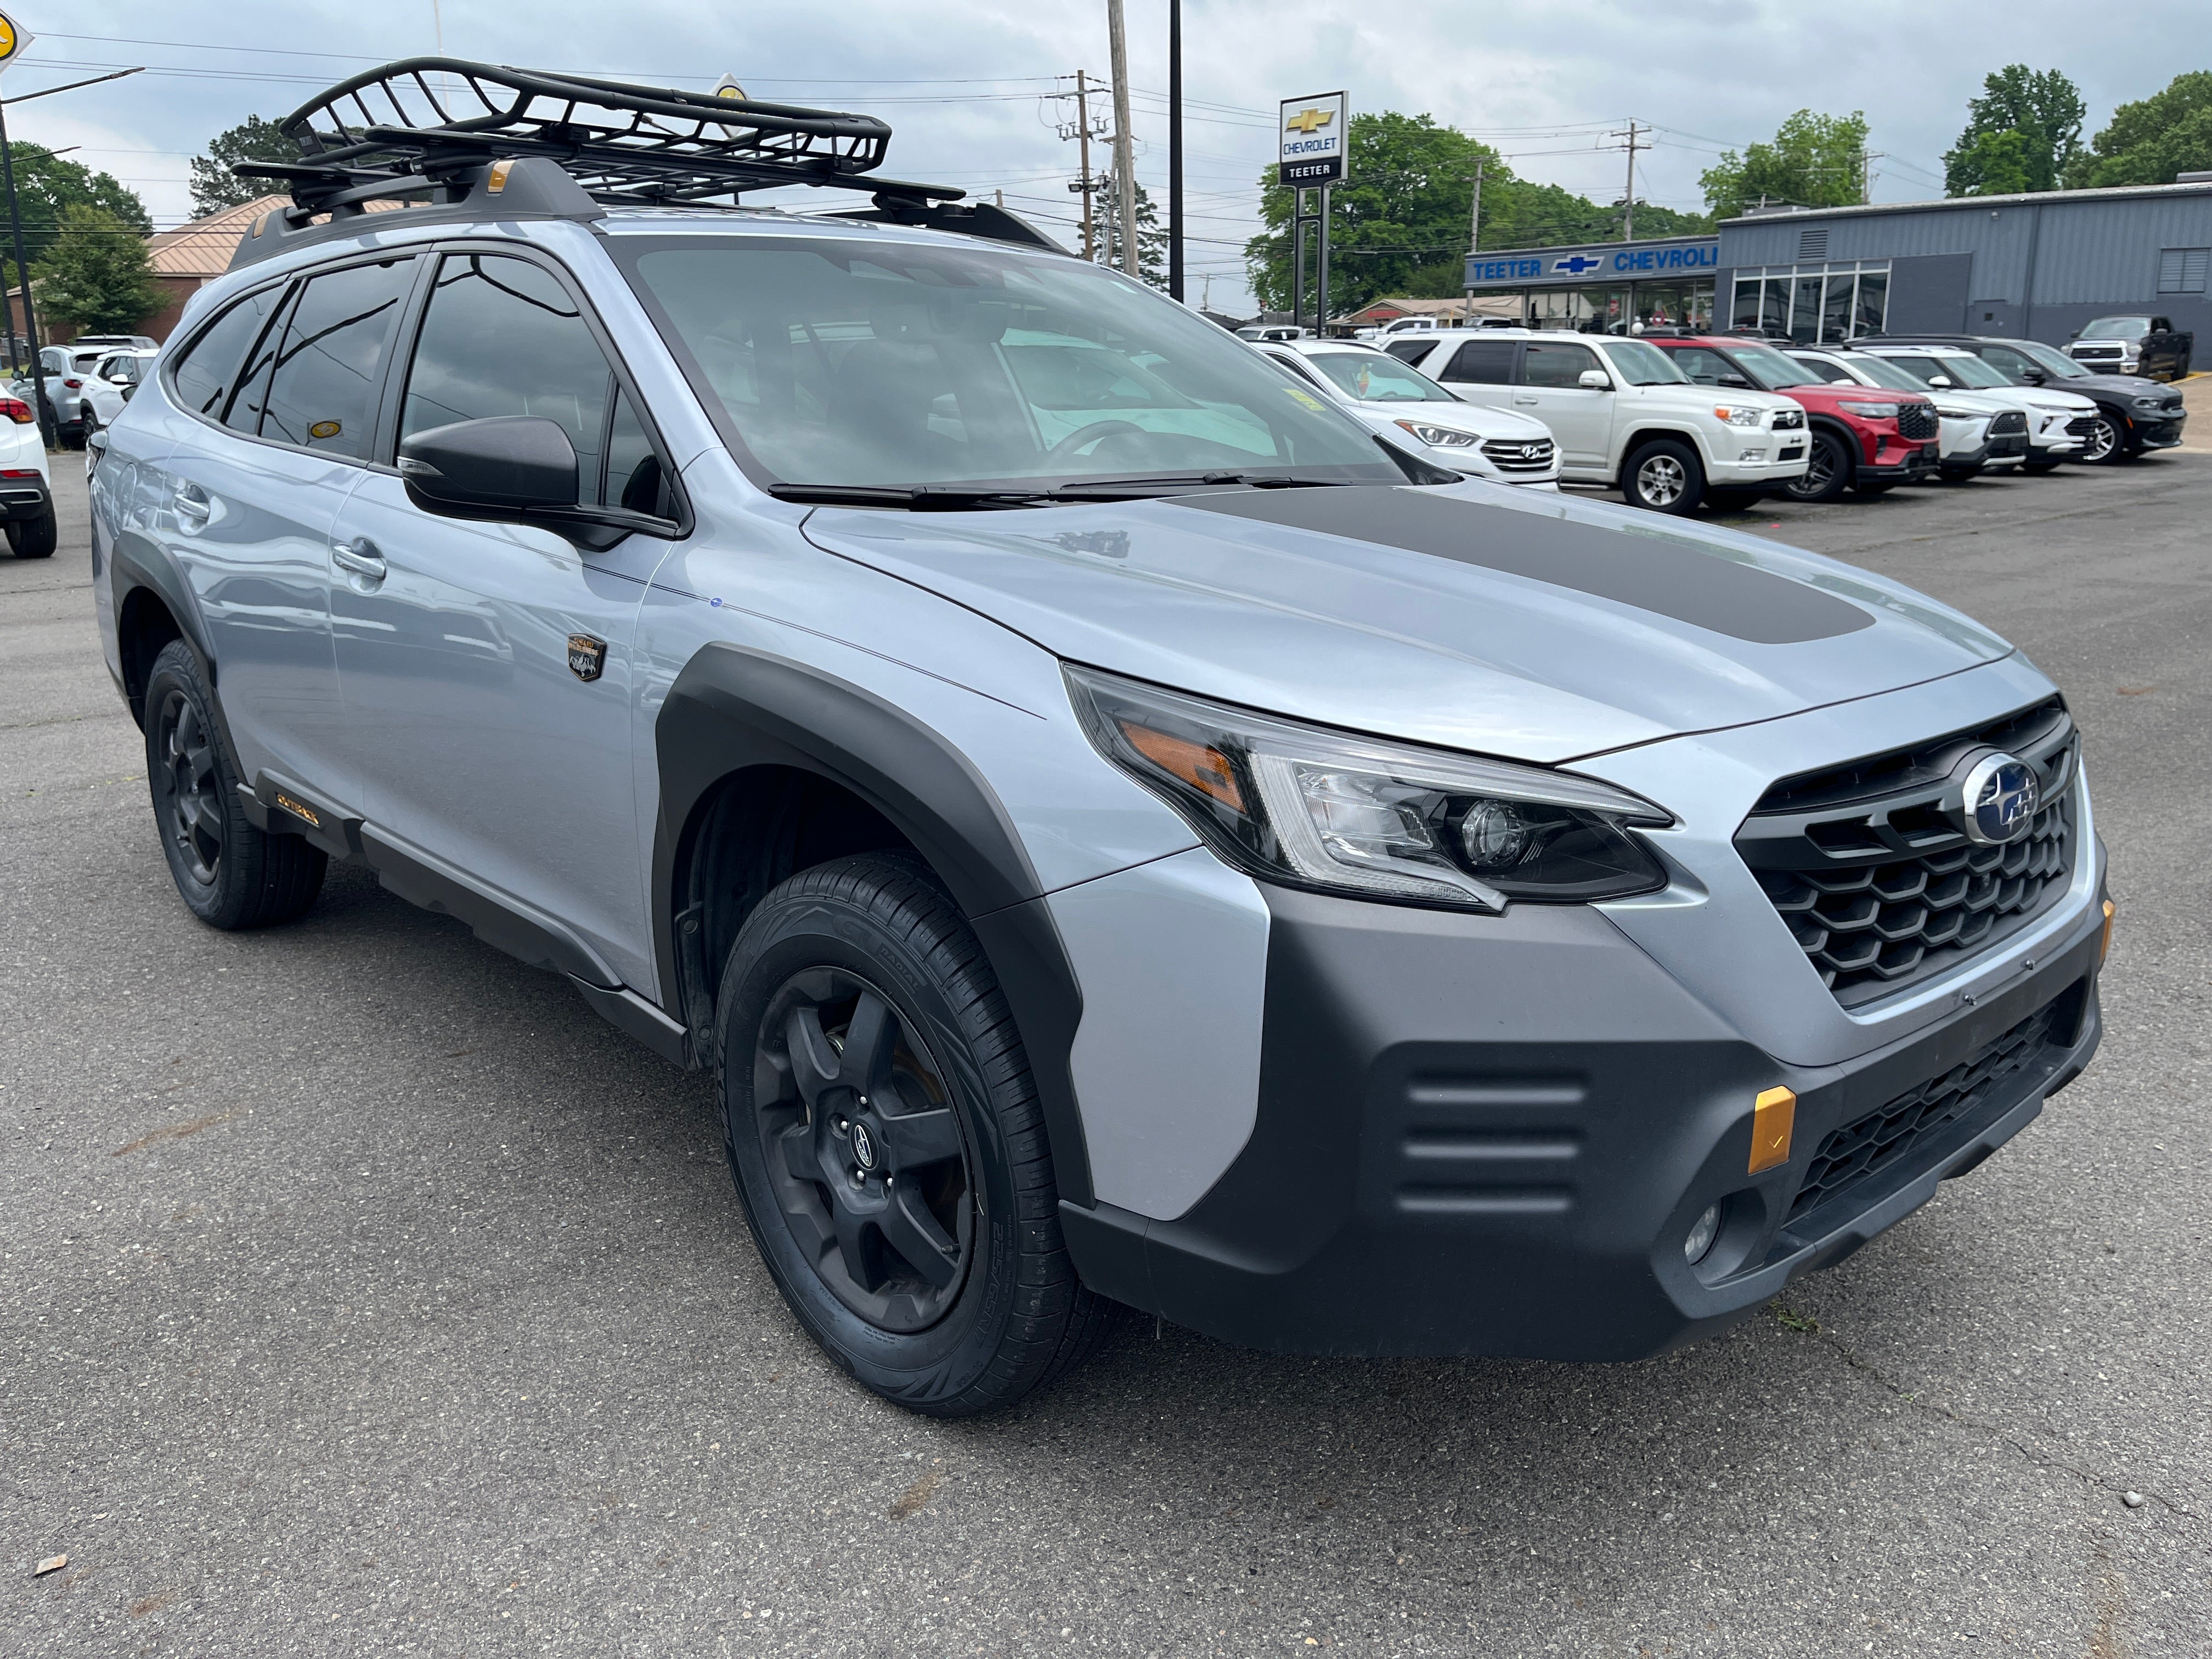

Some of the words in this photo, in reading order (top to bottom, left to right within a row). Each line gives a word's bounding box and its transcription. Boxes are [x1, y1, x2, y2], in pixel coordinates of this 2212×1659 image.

[1284, 137, 1337, 155] CHEVROLET
[1289, 165, 1330, 178] TEETER
[1474, 259, 1542, 280] TEETER
[568, 642, 600, 656] WILDERNESS
[574, 637, 594, 648] SUBARU
[880, 946, 919, 989] RADIAL
